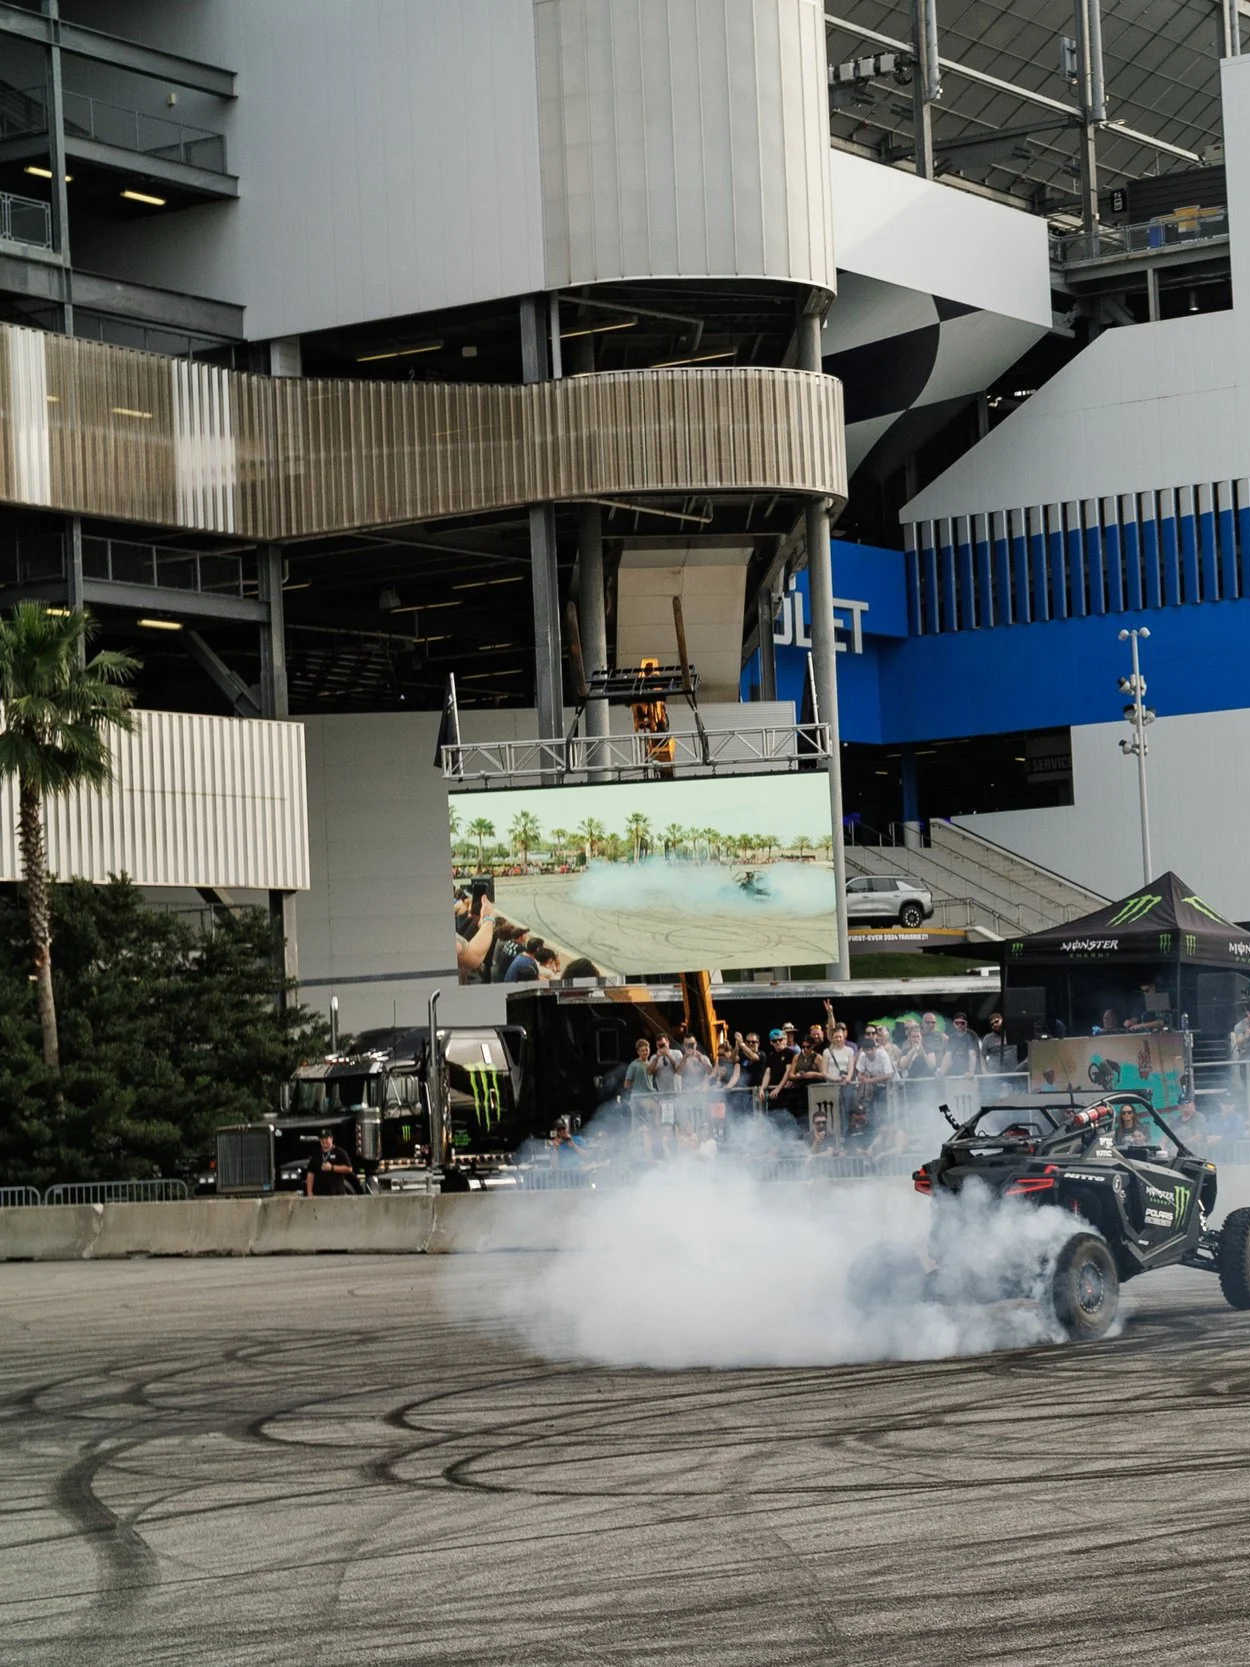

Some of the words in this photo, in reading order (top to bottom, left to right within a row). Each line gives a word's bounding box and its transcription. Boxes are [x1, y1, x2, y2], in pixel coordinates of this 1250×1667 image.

[1060, 938, 1119, 951] MONSTER
[1063, 1172, 1106, 1182] NITTO
[1145, 1208, 1174, 1221] POLARIS
